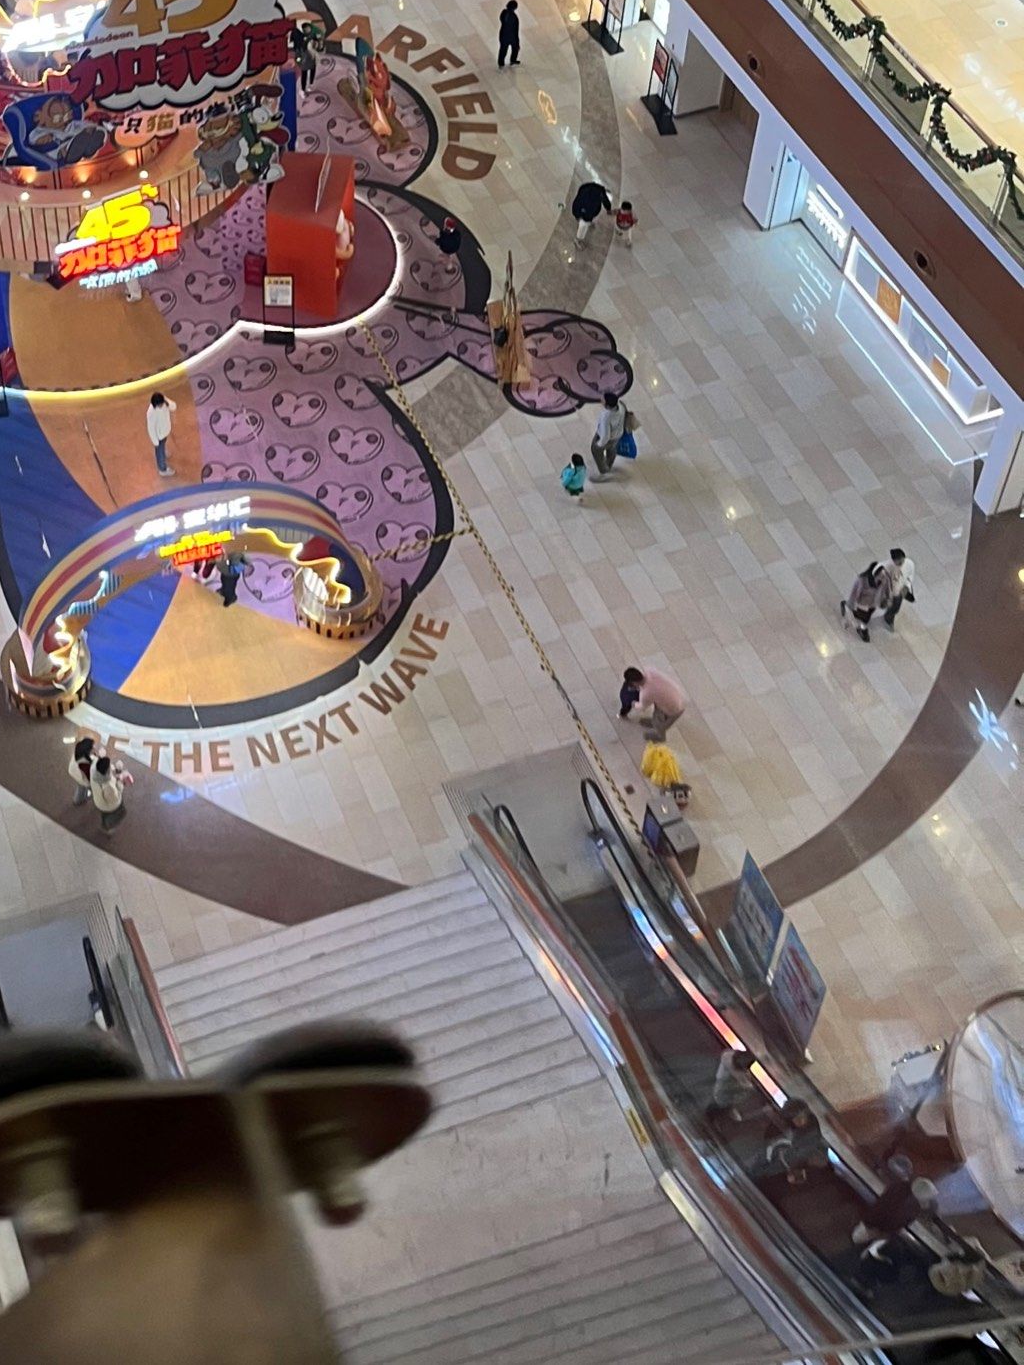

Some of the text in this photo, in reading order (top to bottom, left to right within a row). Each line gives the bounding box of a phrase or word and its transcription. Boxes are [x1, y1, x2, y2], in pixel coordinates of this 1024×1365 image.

[68, 19, 296, 103] 加菲猫
[76, 191, 151, 242] 45
[142, 738, 235, 774] THE
[246, 701, 360, 769] NEXT
[358, 612, 450, 717] WAVE
